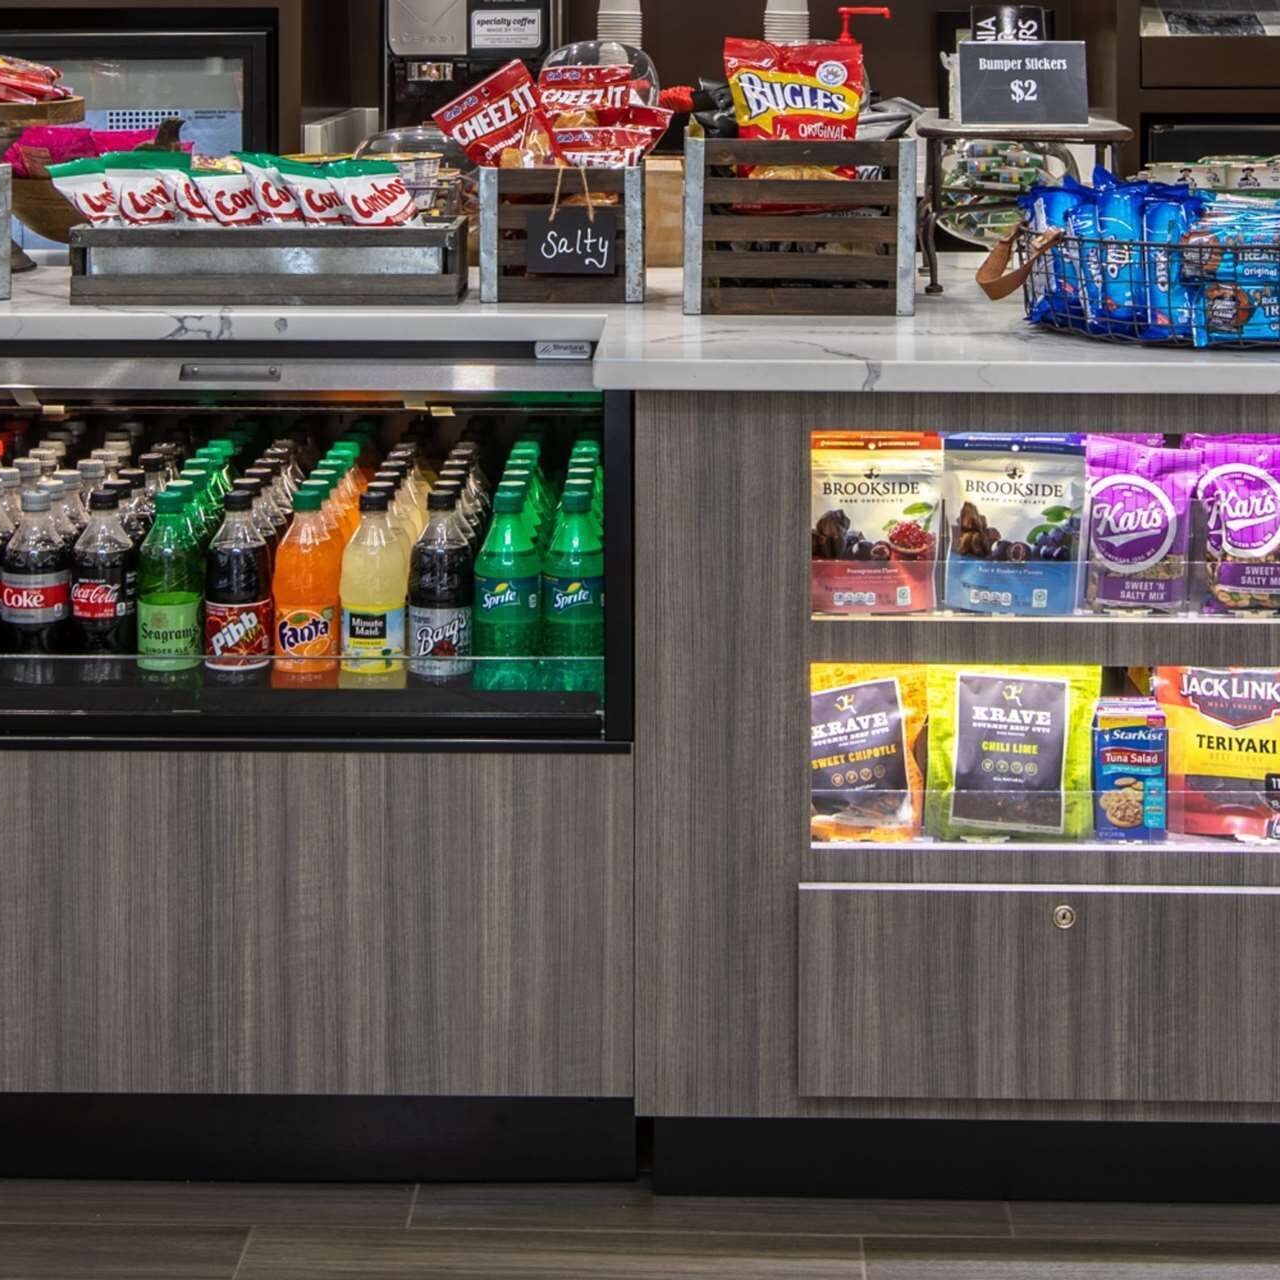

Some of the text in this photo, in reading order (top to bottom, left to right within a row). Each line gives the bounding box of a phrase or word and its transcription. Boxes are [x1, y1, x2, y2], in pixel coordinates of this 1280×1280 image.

[979, 57, 1067, 71] Bumper Stickers
[738, 71, 846, 117] BUGLES
[1010, 79, 1038, 103] $2
[540, 227, 609, 269] Salty
[823, 481, 920, 497] BROOKSIDE
[965, 479, 1064, 498] BROOKSIDE
[1244, 566, 1274, 576] SWEET
[1124, 581, 1154, 591] SWEET
[1240, 576, 1267, 586] SALTY
[3, 588, 44, 609] Coke
[482, 589, 518, 608] Sprite
[553, 589, 591, 609] Sprite
[211, 609, 258, 656] Pibb
[351, 617, 384, 629] Minute
[354, 626, 381, 637] Maid
[278, 620, 329, 651] Fanta
[416, 614, 467, 657] Barq's
[1180, 673, 1231, 700] JACK
[972, 706, 1052, 726] KRAVE
[811, 712, 889, 740] KRAVE
[1111, 729, 1163, 741] StarKist
[982, 740, 1039, 755] CHILI LIME
[1196, 734, 1277, 754] TERIYAKI
[1104, 752, 1158, 764] Tuna Salad
